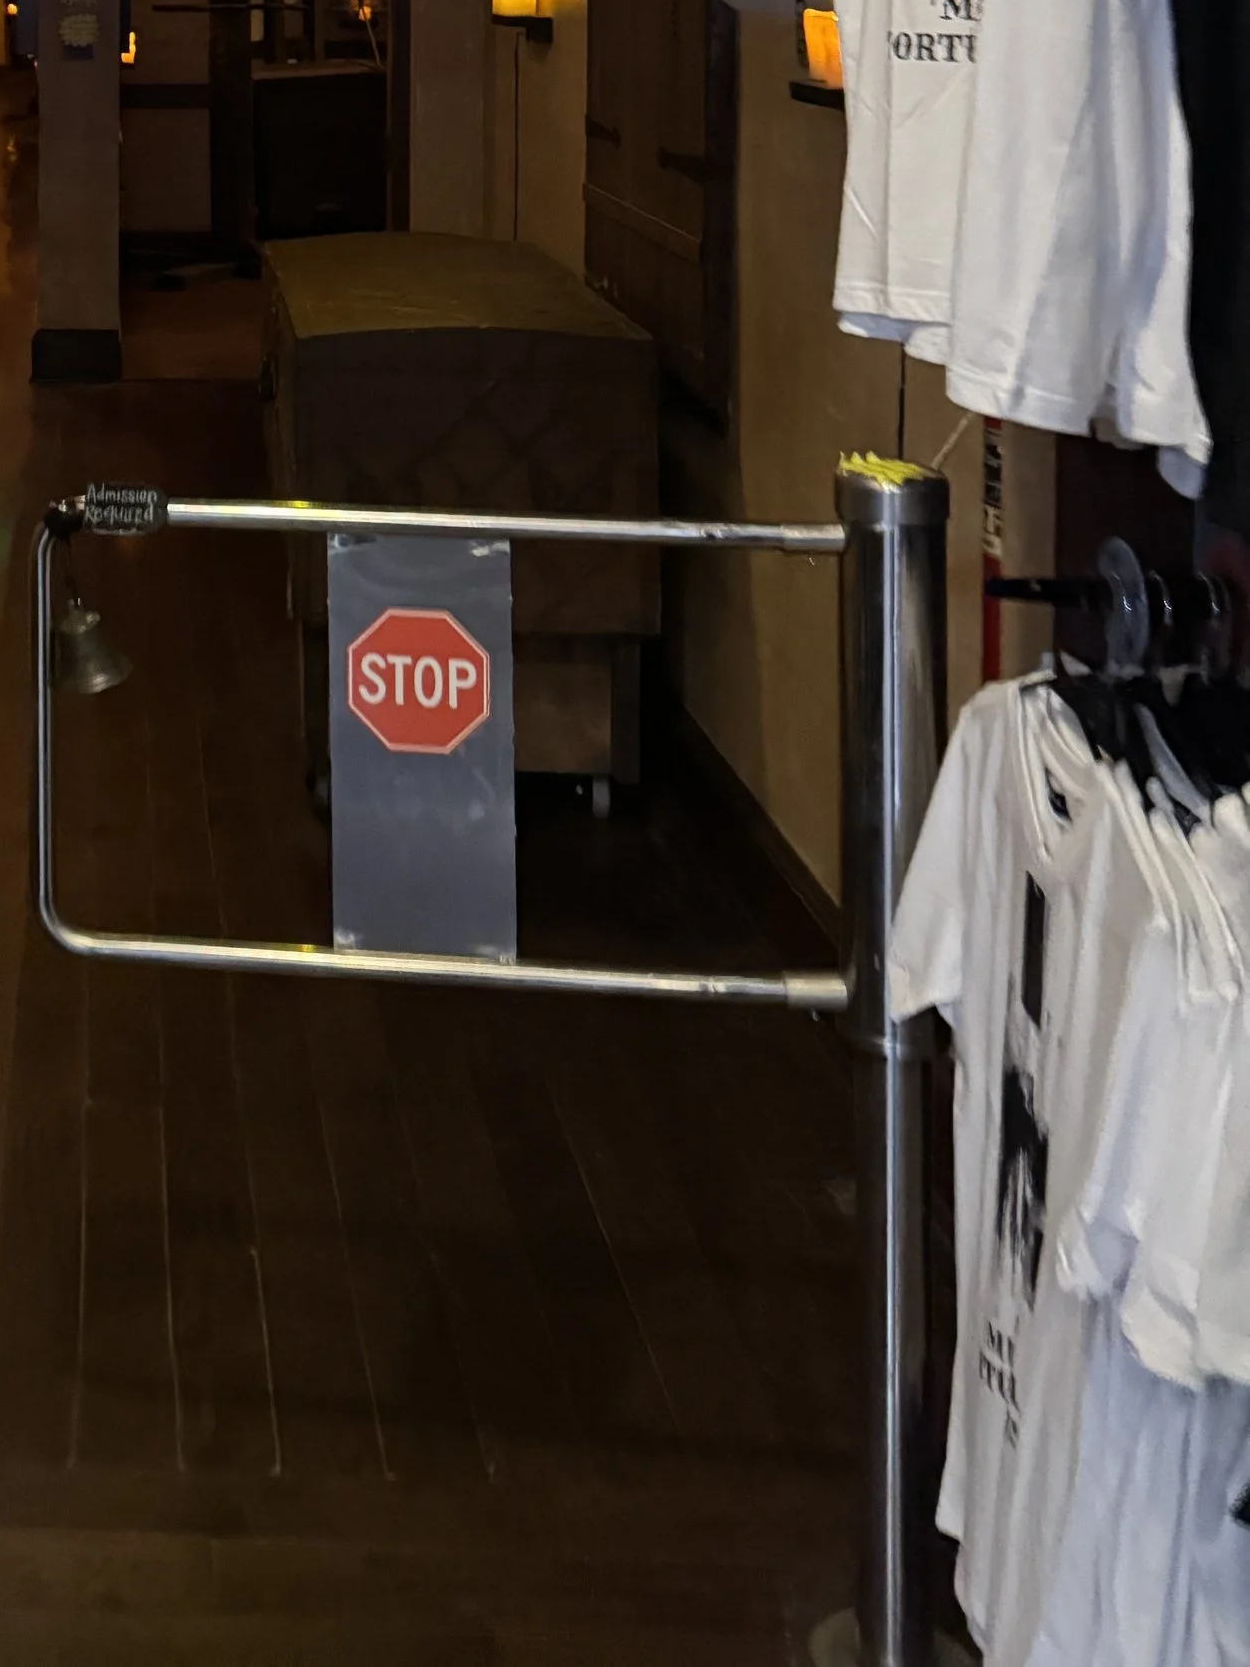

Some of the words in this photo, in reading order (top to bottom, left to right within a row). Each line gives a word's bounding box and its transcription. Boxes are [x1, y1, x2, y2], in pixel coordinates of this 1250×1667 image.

[86, 482, 158, 504] Admission
[84, 501, 154, 525] Required
[358, 652, 477, 709] STOP
